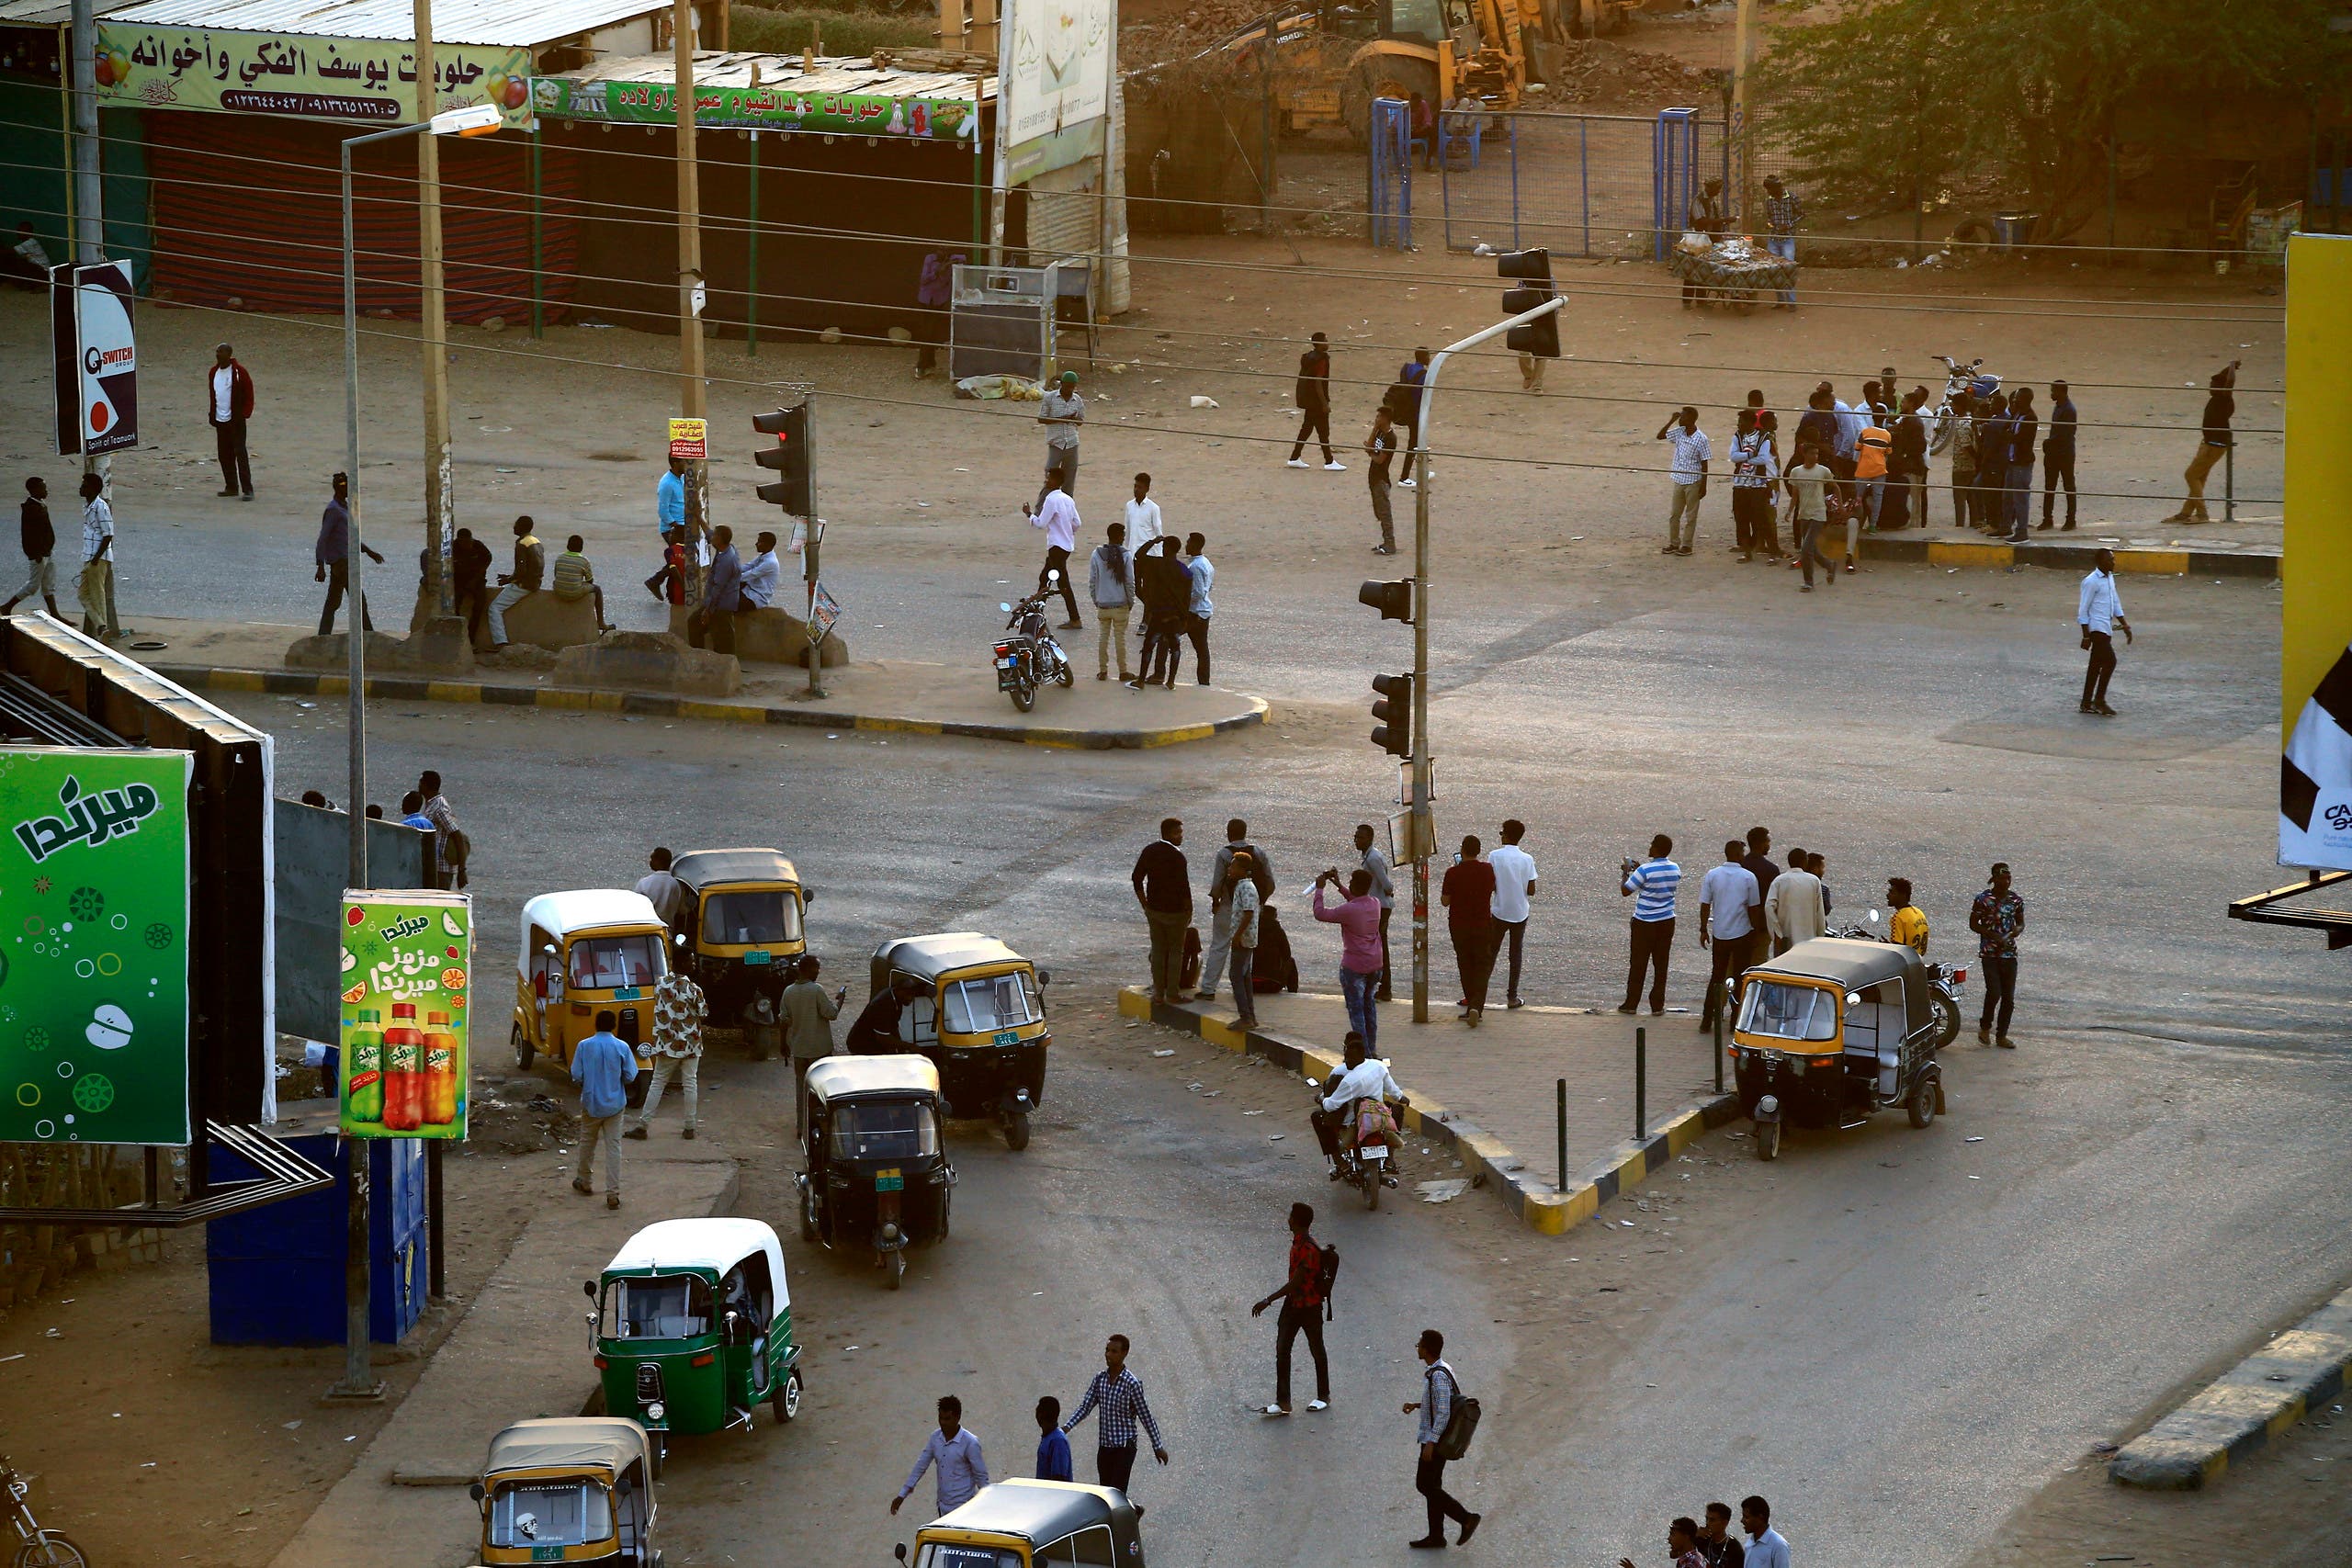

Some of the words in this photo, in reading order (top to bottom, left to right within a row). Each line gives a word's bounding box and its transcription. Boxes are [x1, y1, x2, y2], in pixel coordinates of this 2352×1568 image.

[239, 39, 306, 87] الفكي
[317, 43, 389, 91] يوسف
[398, 53, 484, 93] حلويت
[102, 346, 133, 365] SWITCH
[103, 437, 110, 447] of
[13, 773, 158, 863] ميرندا
[379, 913, 431, 942] ميرندا
[378, 946, 440, 976] مزمز
[369, 967, 438, 1000] ميرندا
